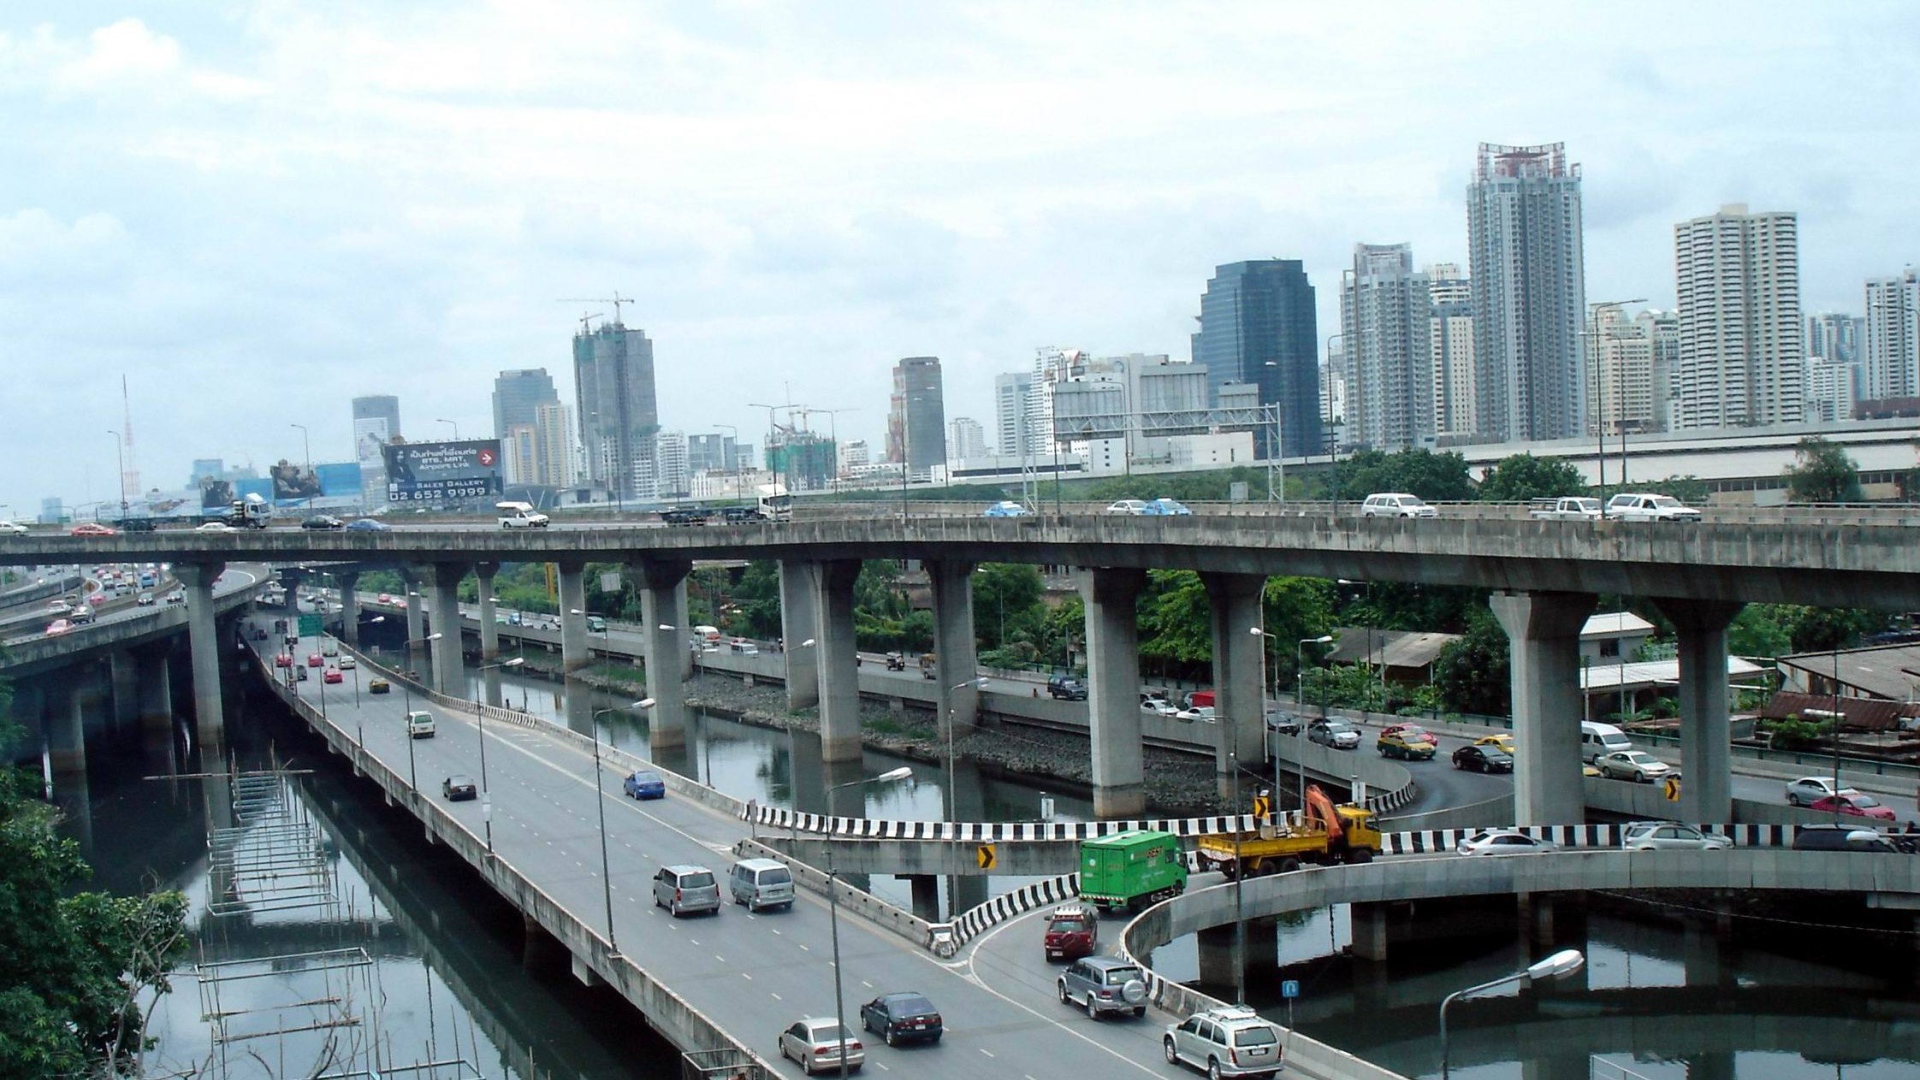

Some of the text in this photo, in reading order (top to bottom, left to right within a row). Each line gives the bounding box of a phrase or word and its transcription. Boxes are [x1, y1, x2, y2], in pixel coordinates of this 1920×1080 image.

[389, 487, 486, 501] 02 652 9999
